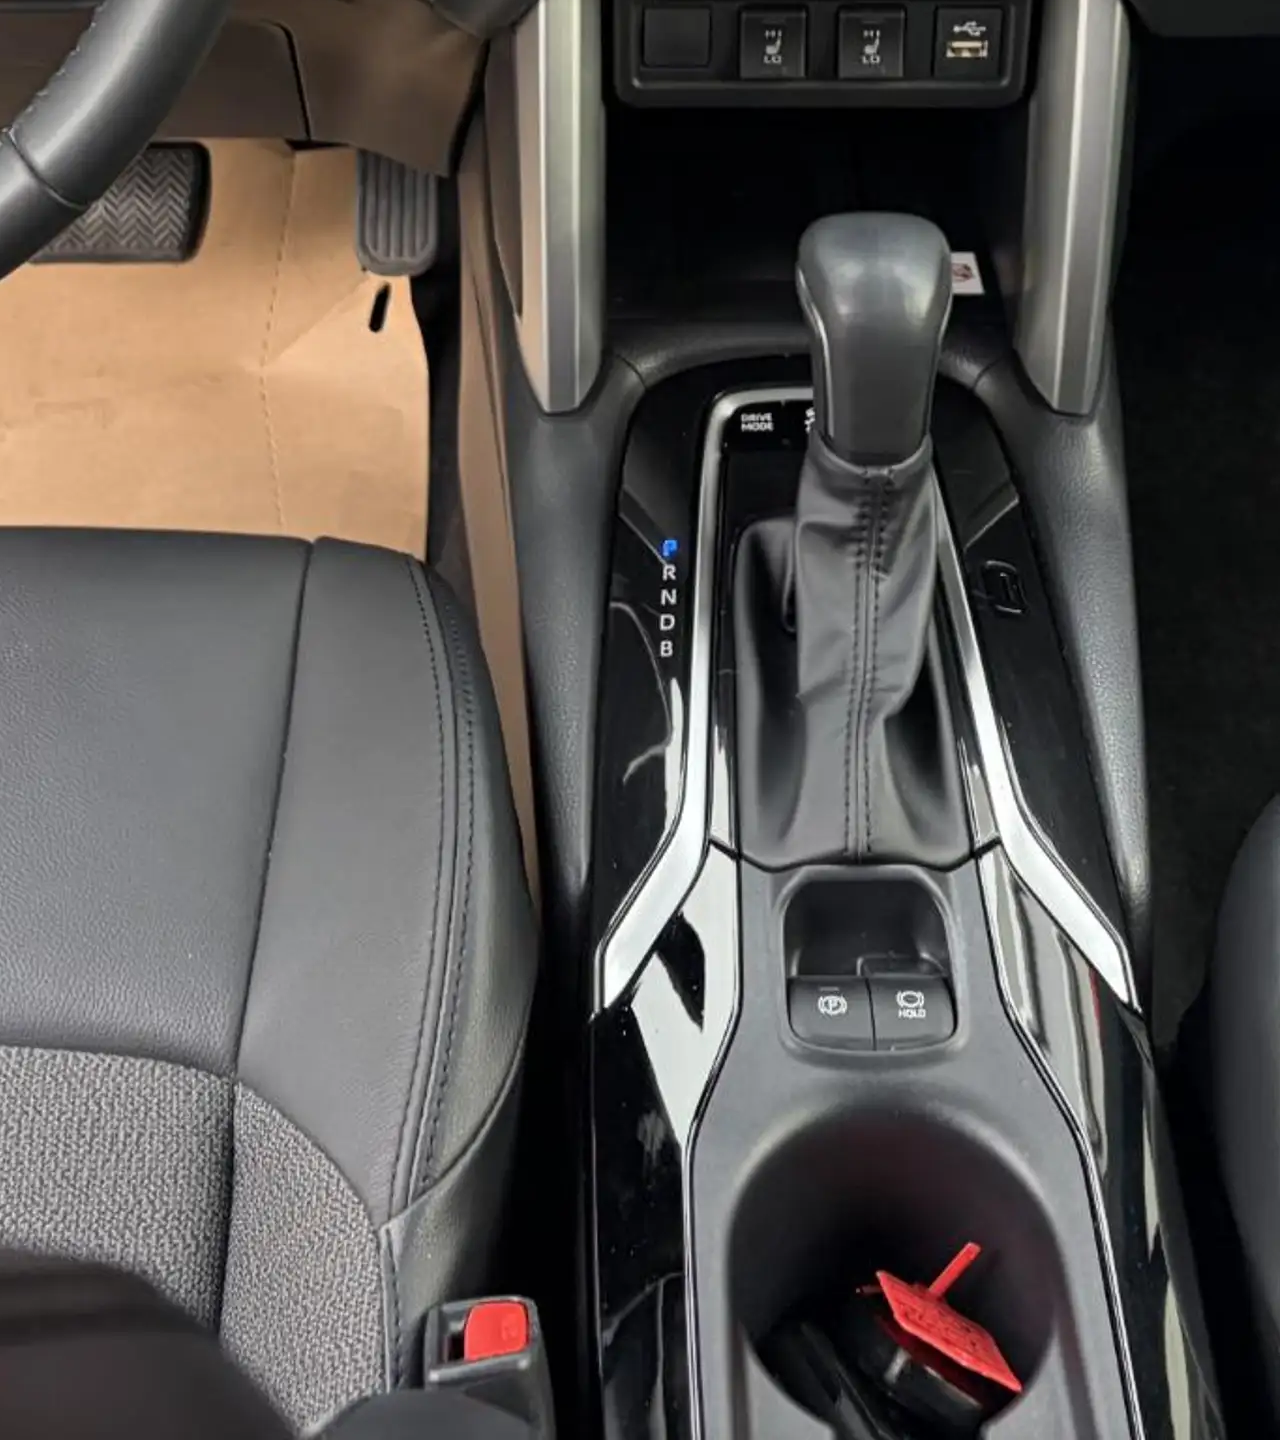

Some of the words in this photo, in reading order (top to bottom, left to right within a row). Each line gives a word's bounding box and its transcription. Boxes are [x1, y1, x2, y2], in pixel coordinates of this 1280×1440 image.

[740, 412, 773, 422] DRIVE
[740, 421, 774, 432] MODE
[662, 539, 678, 557] P
[662, 563, 677, 581] R
[661, 588, 677, 605] N
[659, 613, 676, 631] D
[659, 640, 674, 658] B
[897, 1008, 927, 1019] HOLD
